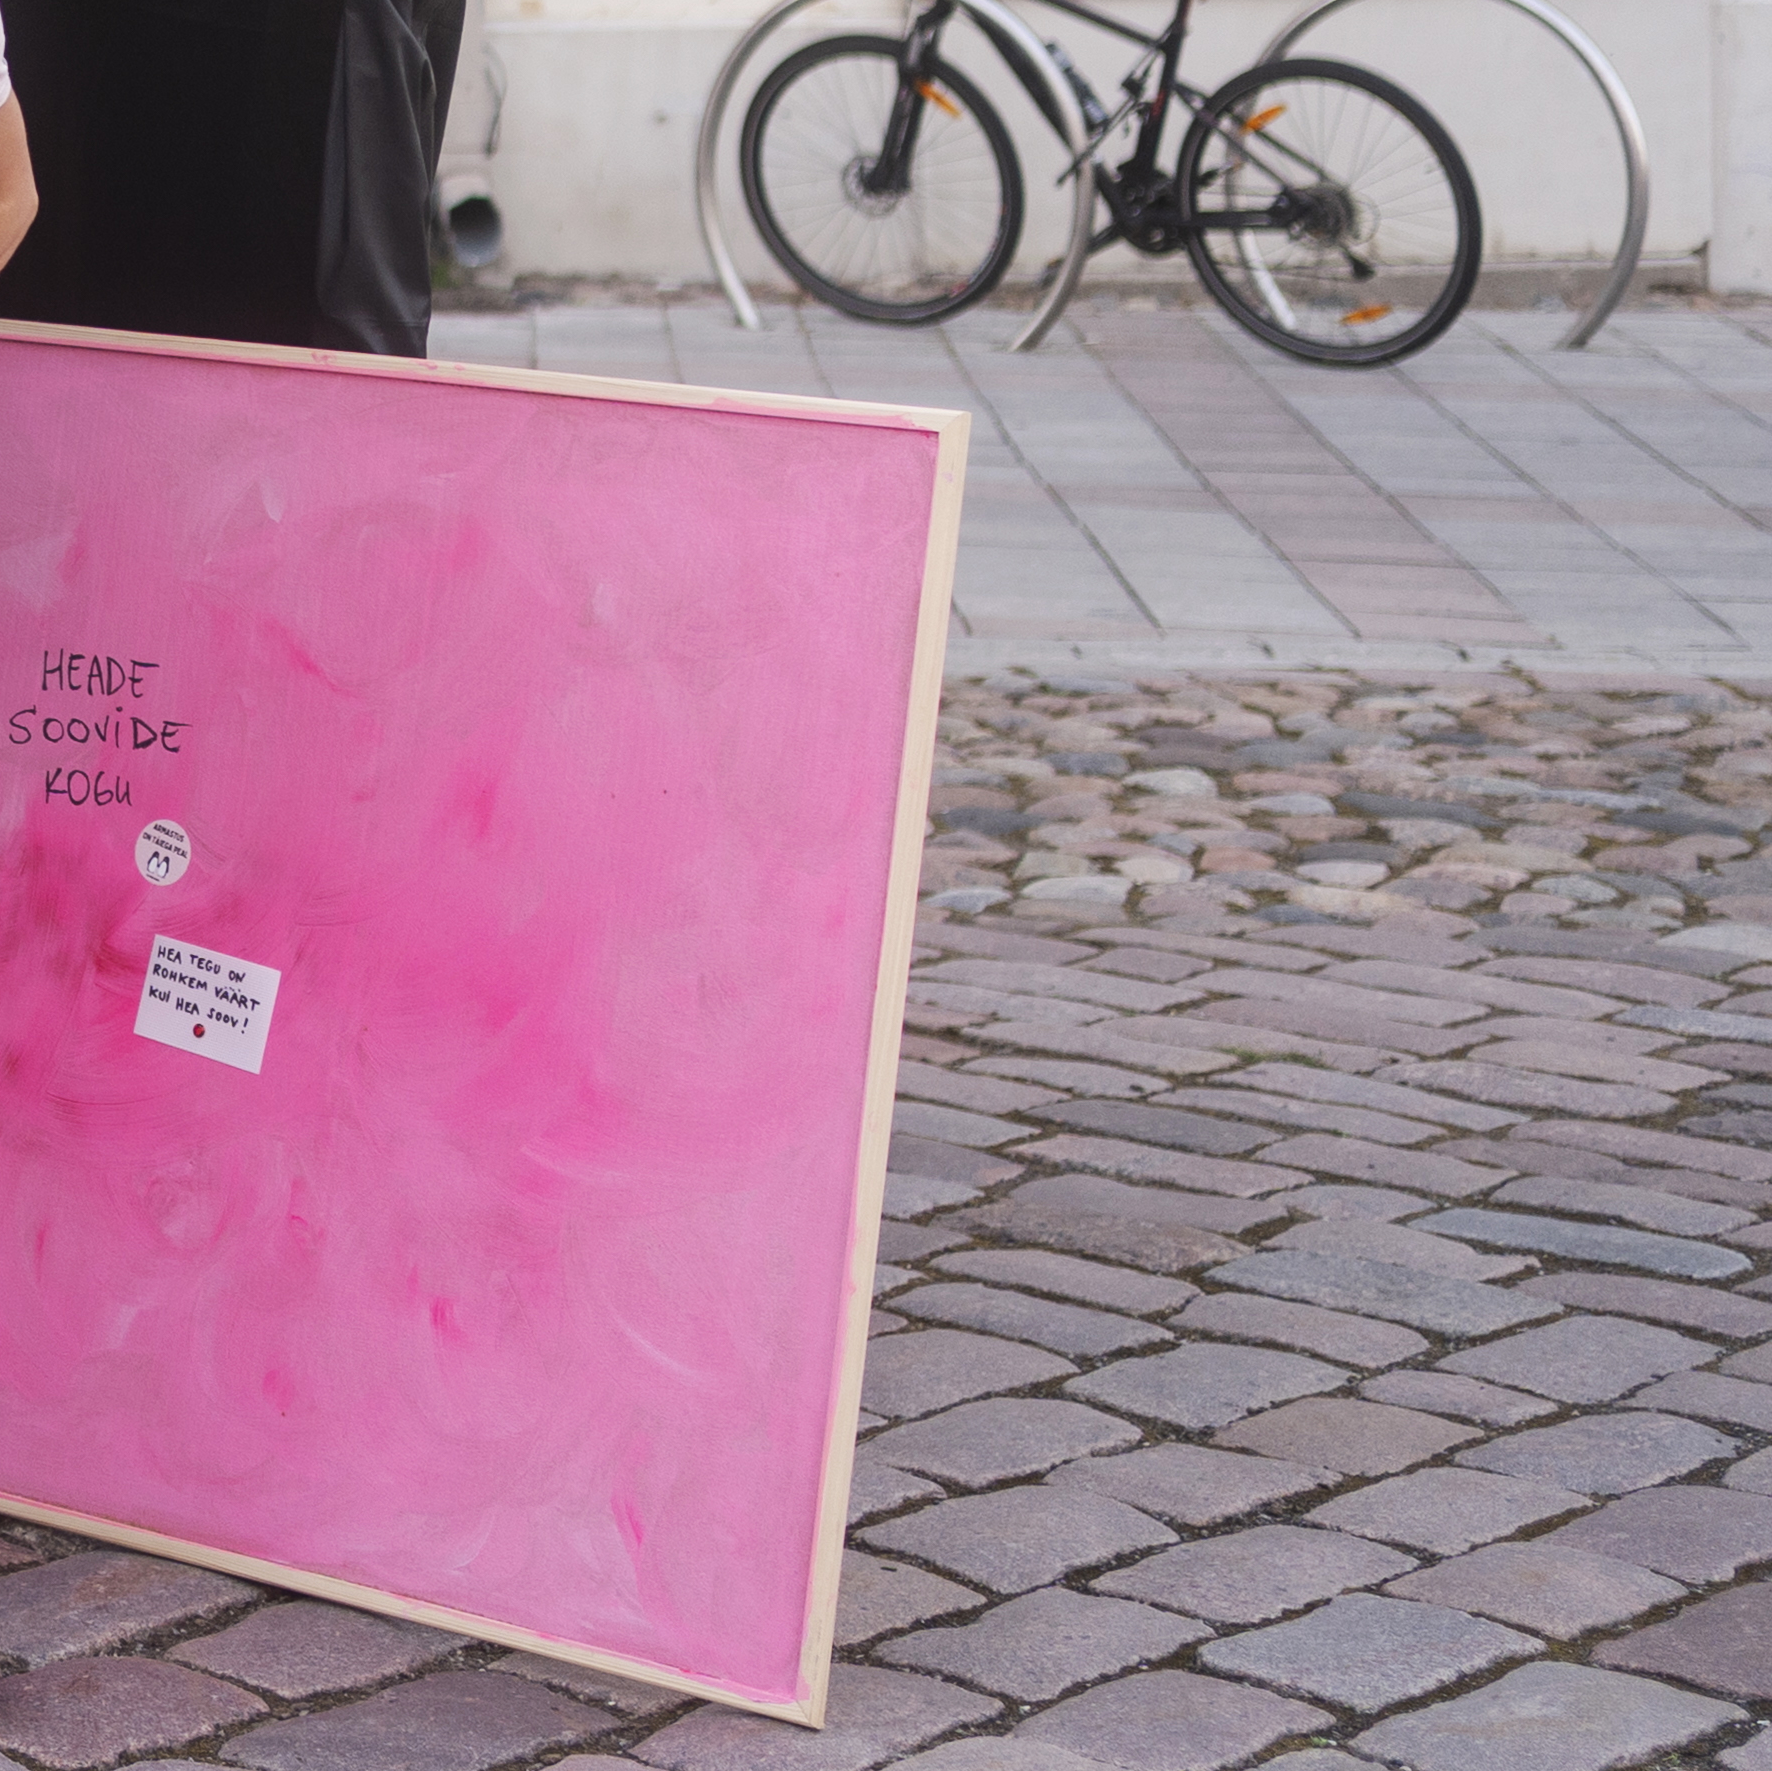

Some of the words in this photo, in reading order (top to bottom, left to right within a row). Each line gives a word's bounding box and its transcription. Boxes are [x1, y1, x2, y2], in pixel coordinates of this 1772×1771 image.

[40, 649, 159, 699] HEADE
[157, 945, 182, 965] HEA
[189, 953, 221, 975] TEGU
[228, 969, 246, 983] ON
[152, 963, 208, 991] ROHKEM
[214, 986, 261, 1012] VÄÄRT
[175, 997, 200, 1016] HEA
